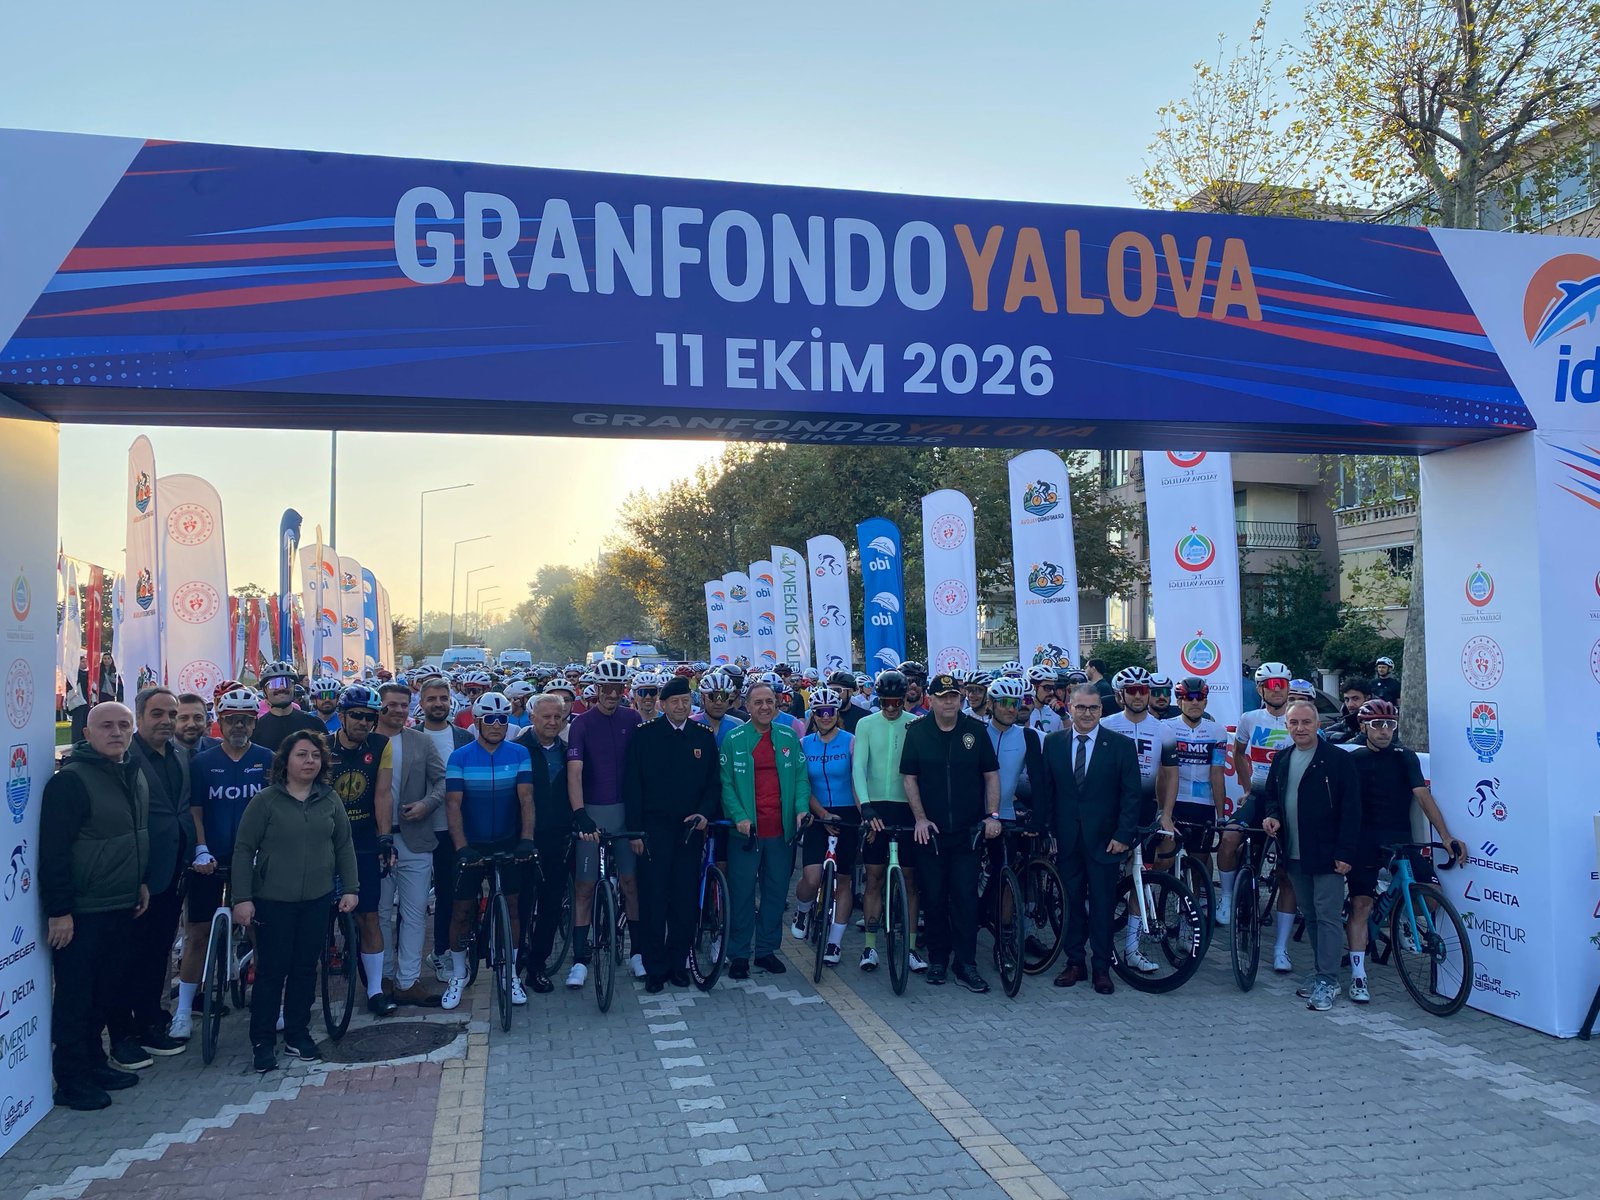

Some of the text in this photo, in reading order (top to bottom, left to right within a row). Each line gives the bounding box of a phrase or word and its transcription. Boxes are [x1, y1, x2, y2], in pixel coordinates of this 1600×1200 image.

[656, 327, 1054, 396] 11 EKİM 2026
[853, 434, 946, 443] 2026
[1484, 888, 1519, 907] DELTA
[1474, 918, 1526, 944] MERTUR
[1480, 934, 1511, 954] OTEL
[12, 979, 35, 1005] DELTA
[8, 1043, 29, 1069] OTEL
